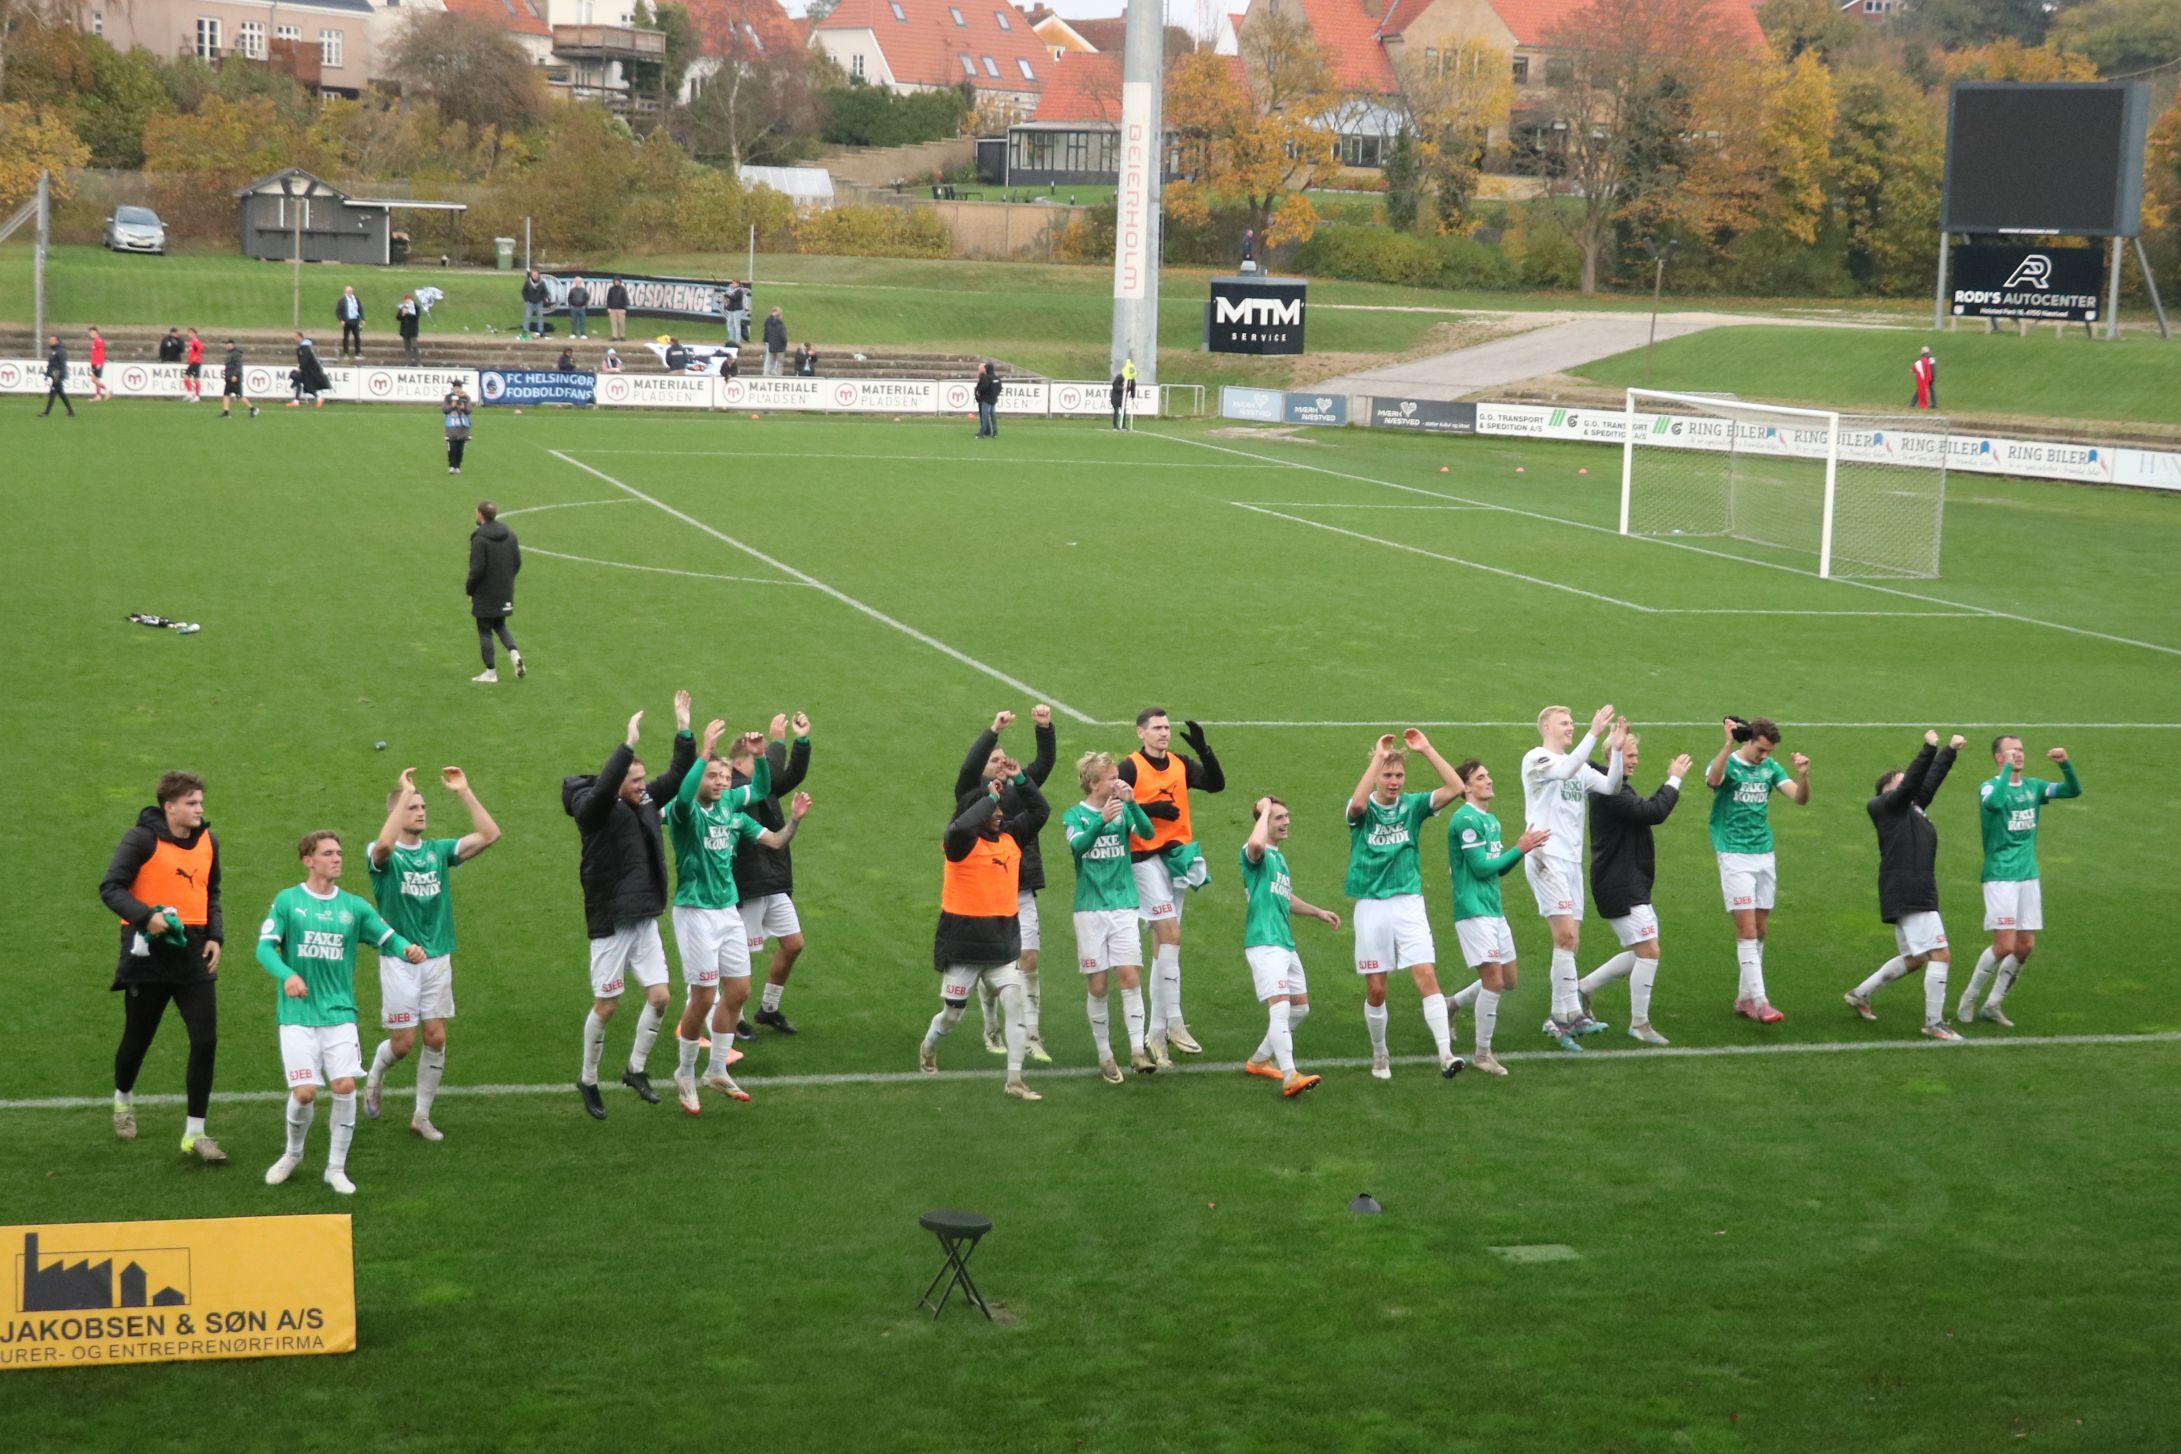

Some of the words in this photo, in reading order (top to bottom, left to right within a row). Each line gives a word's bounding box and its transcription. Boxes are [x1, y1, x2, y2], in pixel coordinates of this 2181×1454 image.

[1124, 124, 1142, 290] BEIERHOLM
[1955, 290, 2001, 304] RODI'S
[2003, 292, 2097, 308] AUTOCENTER
[1215, 296, 1301, 325] MTM
[1232, 332, 1287, 342] SERVICE
[507, 373, 522, 384] FC
[526, 374, 594, 387] HELSINGØR
[634, 380, 704, 392] MATERIALE
[749, 383, 818, 394] MATERIALE
[862, 386, 930, 397] MATERIALE
[633, 391, 693, 402] PLADSEN
[749, 393, 807, 405] PLADSEN
[861, 396, 919, 408] PLADSEN
[1498, 414, 1544, 423] TRANSPORT
[1487, 423, 1527, 431] SPEDITION
[1602, 421, 1648, 431] TRANSORT
[1689, 422, 1722, 437] RING
[1793, 430, 1828, 444] RING
[1901, 438, 1934, 452] RING
[2008, 446, 2042, 461] RING
[2047, 449, 2088, 464] BILER
[1375, 821, 1404, 835] FAXE
[1093, 835, 1120, 847] AXE
[1368, 830, 1410, 846] KONDI
[403, 871, 437, 885] FAXE
[1152, 903, 1173, 915] SJEB
[304, 930, 344, 946] FAXE
[747, 936, 763, 947] JEB
[297, 943, 344, 961] KONDI
[1359, 959, 1379, 970] SJEB
[602, 978, 624, 993] SJEB
[945, 984, 966, 996] SJEB
[388, 1012, 411, 1024] SJEB
[289, 1068, 312, 1081] SJEB
[0, 1314, 165, 1343] JAKOBSEN
[176, 1313, 195, 1335] &
[205, 1310, 266, 1334] SØN
[277, 1307, 324, 1331] A/S
[72, 1345, 102, 1360] OG
[109, 1335, 325, 1359] ENTREPRENØRFIRMA
